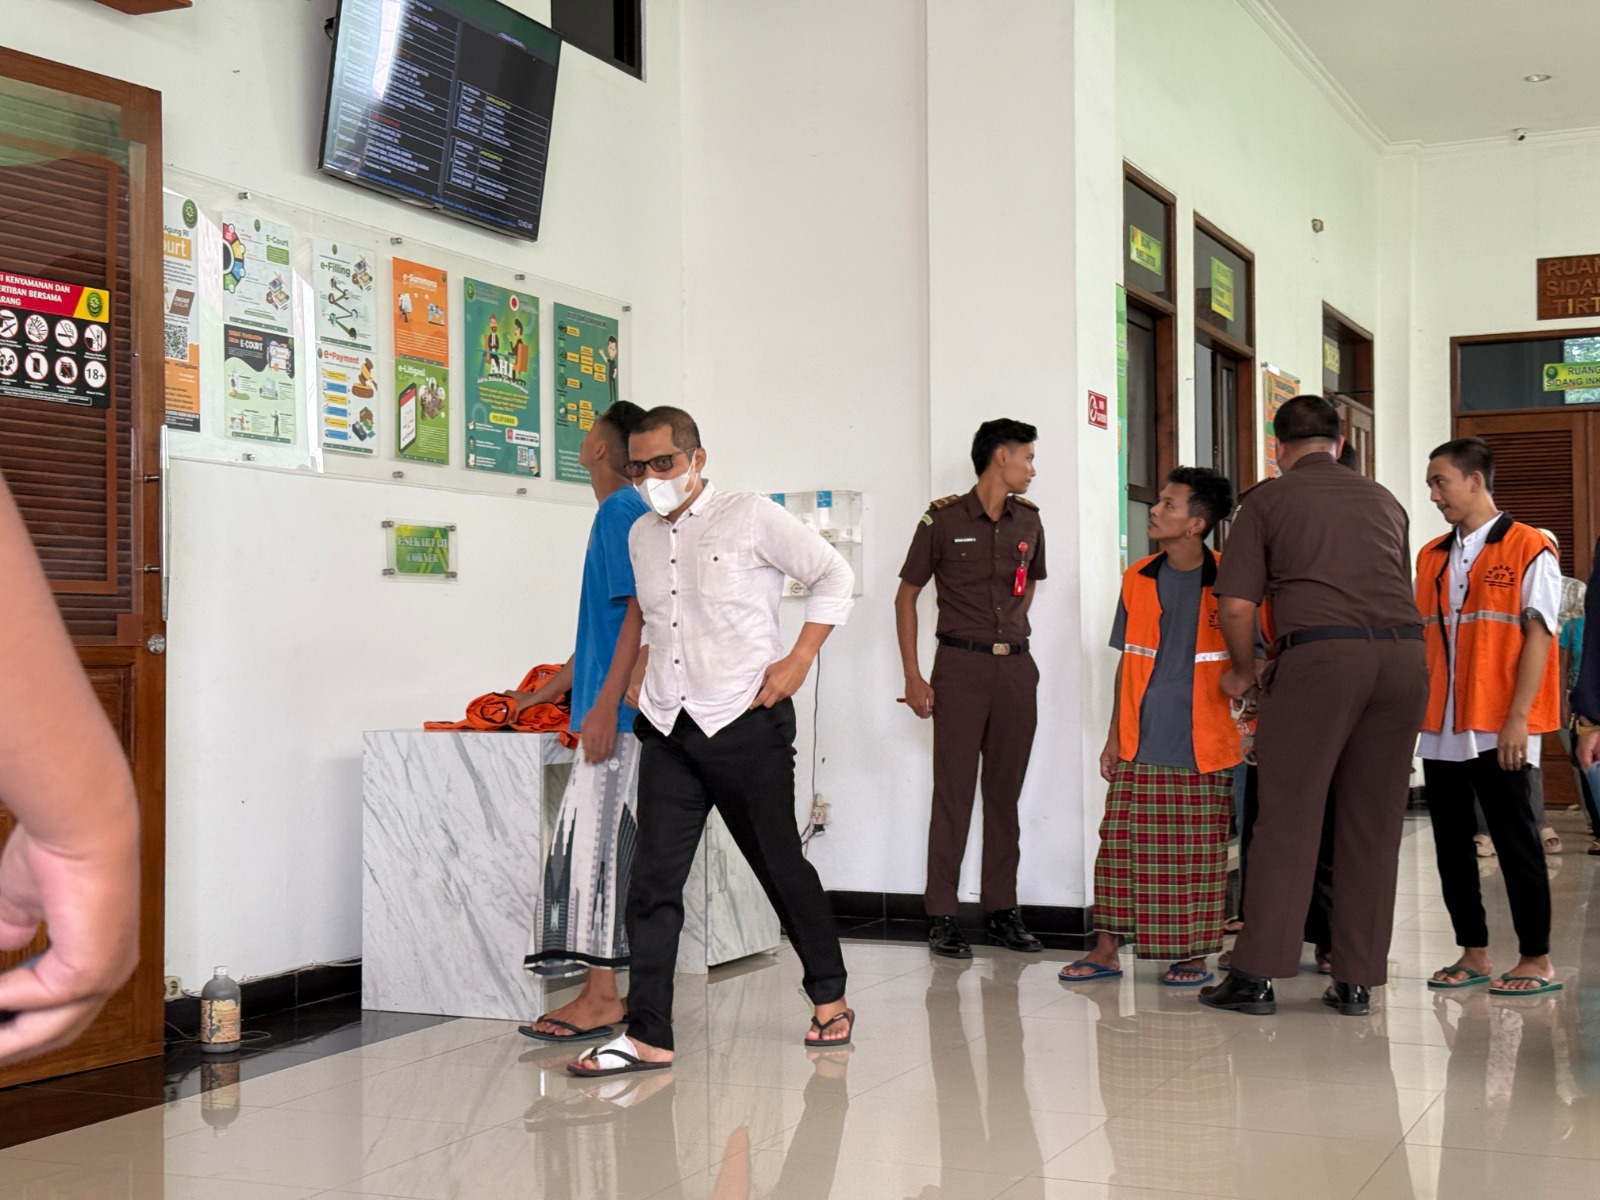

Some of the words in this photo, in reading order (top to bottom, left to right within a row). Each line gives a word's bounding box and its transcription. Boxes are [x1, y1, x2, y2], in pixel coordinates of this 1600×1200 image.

[5, 275, 54, 291] KENYAMANAN
[55, 284, 70, 293] DAN
[28, 290, 62, 303] BERSAMA
[240, 339, 264, 351] E-COURT
[86, 368, 105, 380] 18+
[489, 357, 514, 379] AHI
[1546, 378, 1583, 387] SIDANG
